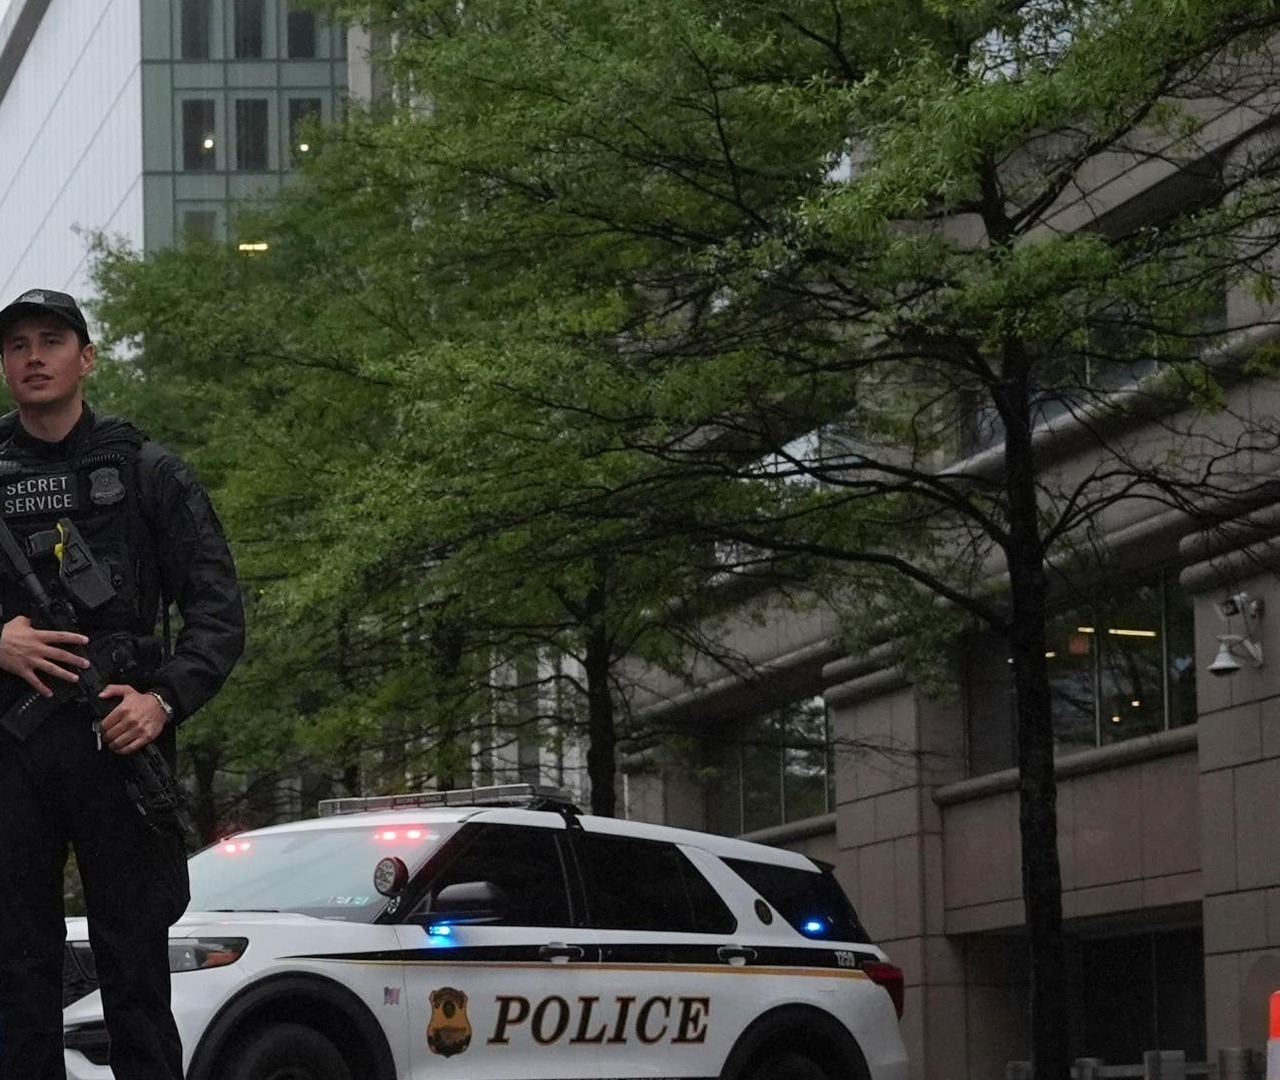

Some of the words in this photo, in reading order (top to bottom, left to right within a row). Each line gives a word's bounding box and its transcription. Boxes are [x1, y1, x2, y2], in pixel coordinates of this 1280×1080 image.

[6, 477, 67, 496] SECRET
[4, 494, 73, 514] SERVICE
[486, 994, 711, 1046] POLICE
